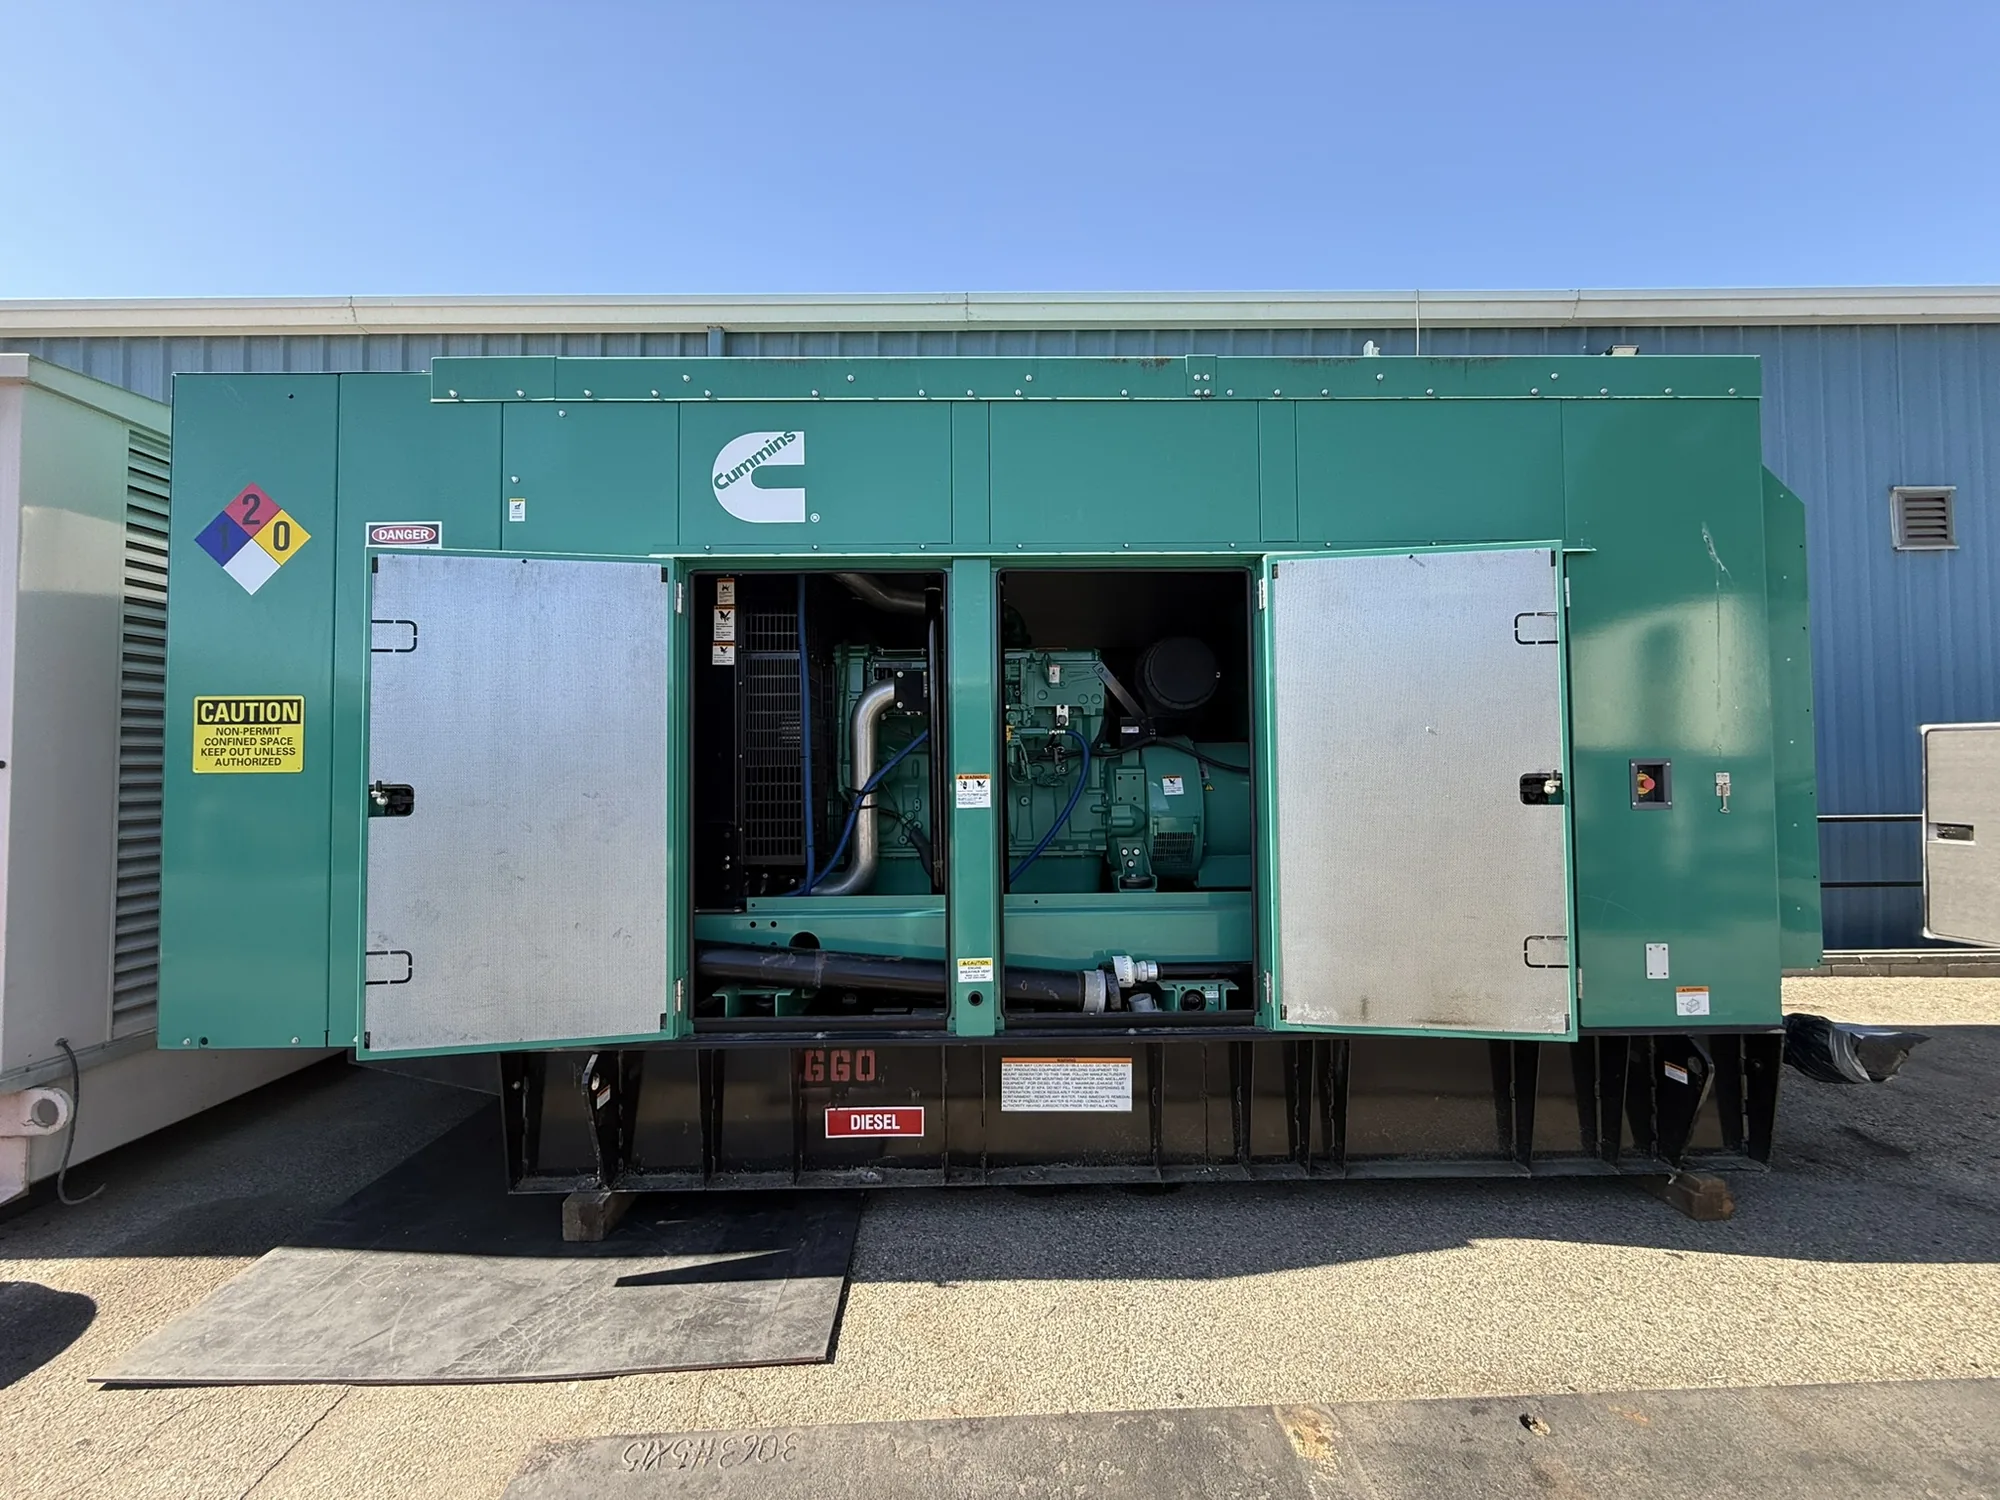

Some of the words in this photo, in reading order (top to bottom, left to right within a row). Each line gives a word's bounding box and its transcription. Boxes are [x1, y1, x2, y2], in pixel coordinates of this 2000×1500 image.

[713, 430, 797, 490] Cummins
[242, 493, 261, 525] 2
[273, 520, 291, 552] 0
[378, 529, 430, 540] DANGER
[200, 702, 298, 722] CAUTION
[215, 727, 282, 736] NON-PERMIT
[204, 737, 257, 746] CONFINED
[260, 737, 293, 746] SPACE
[200, 748, 226, 756] KEEP
[229, 747, 252, 756] OUT
[254, 747, 296, 756] UNLESS
[214, 758, 282, 766] AUTHORIZED
[850, 1114, 901, 1130] DIESEL
